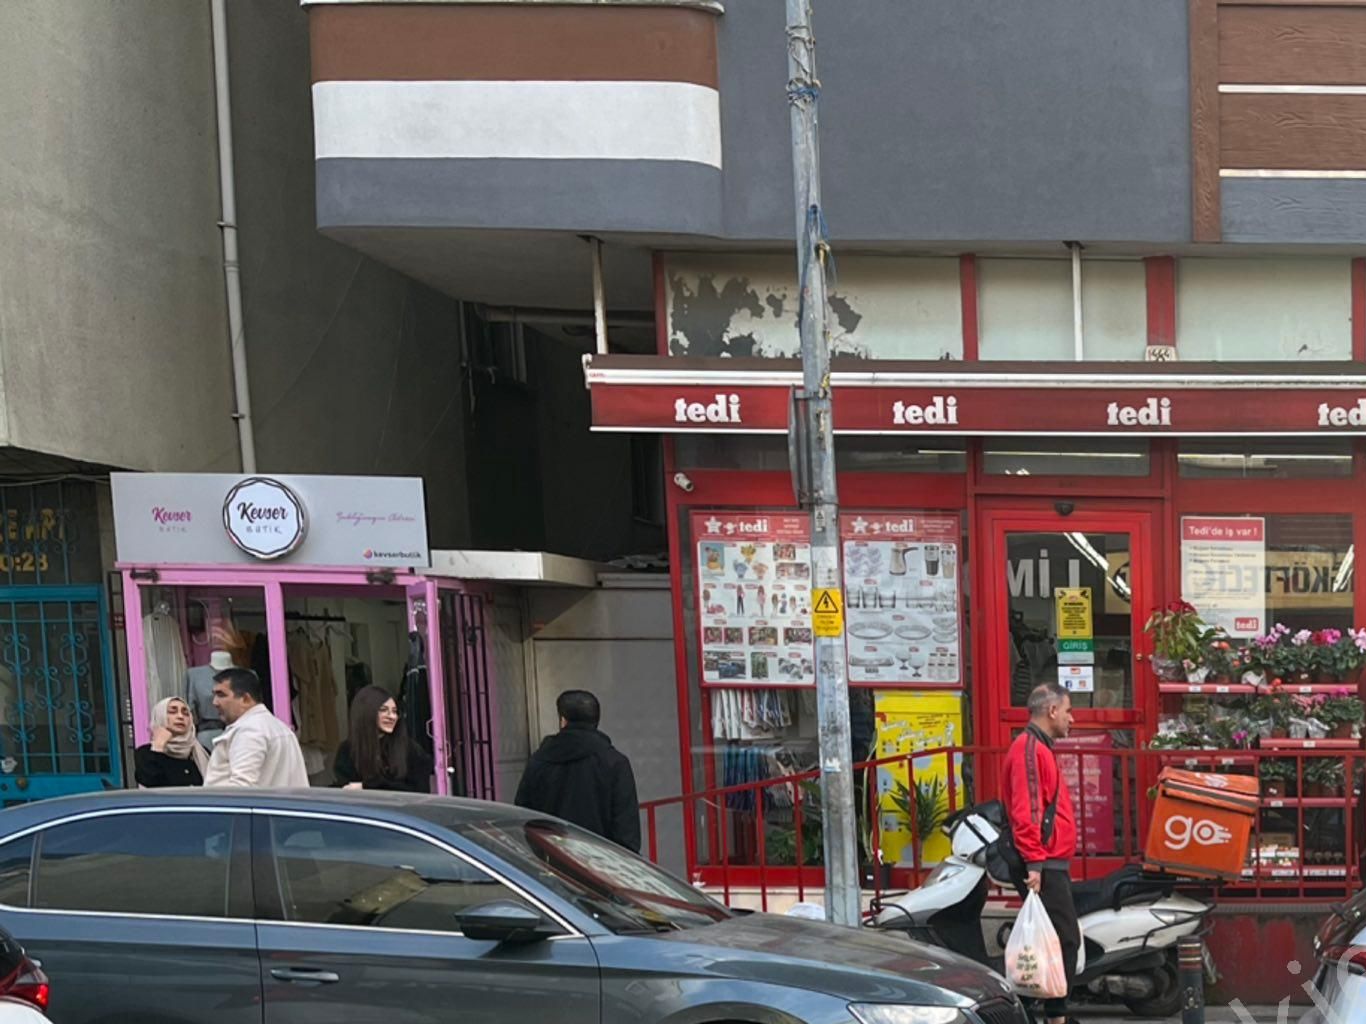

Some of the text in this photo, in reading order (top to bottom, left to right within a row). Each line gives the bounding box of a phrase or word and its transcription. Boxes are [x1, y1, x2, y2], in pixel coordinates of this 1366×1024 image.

[674, 394, 741, 423] tedi
[893, 396, 958, 425] tedi
[1107, 397, 1172, 425] tedi
[152, 507, 192, 524] Kevser
[237, 502, 288, 523] Kevser
[739, 517, 768, 533] tedi
[885, 517, 914, 533] tedi
[1189, 526, 1223, 536] Tedi'de
[1236, 620, 1258, 630] tedi
